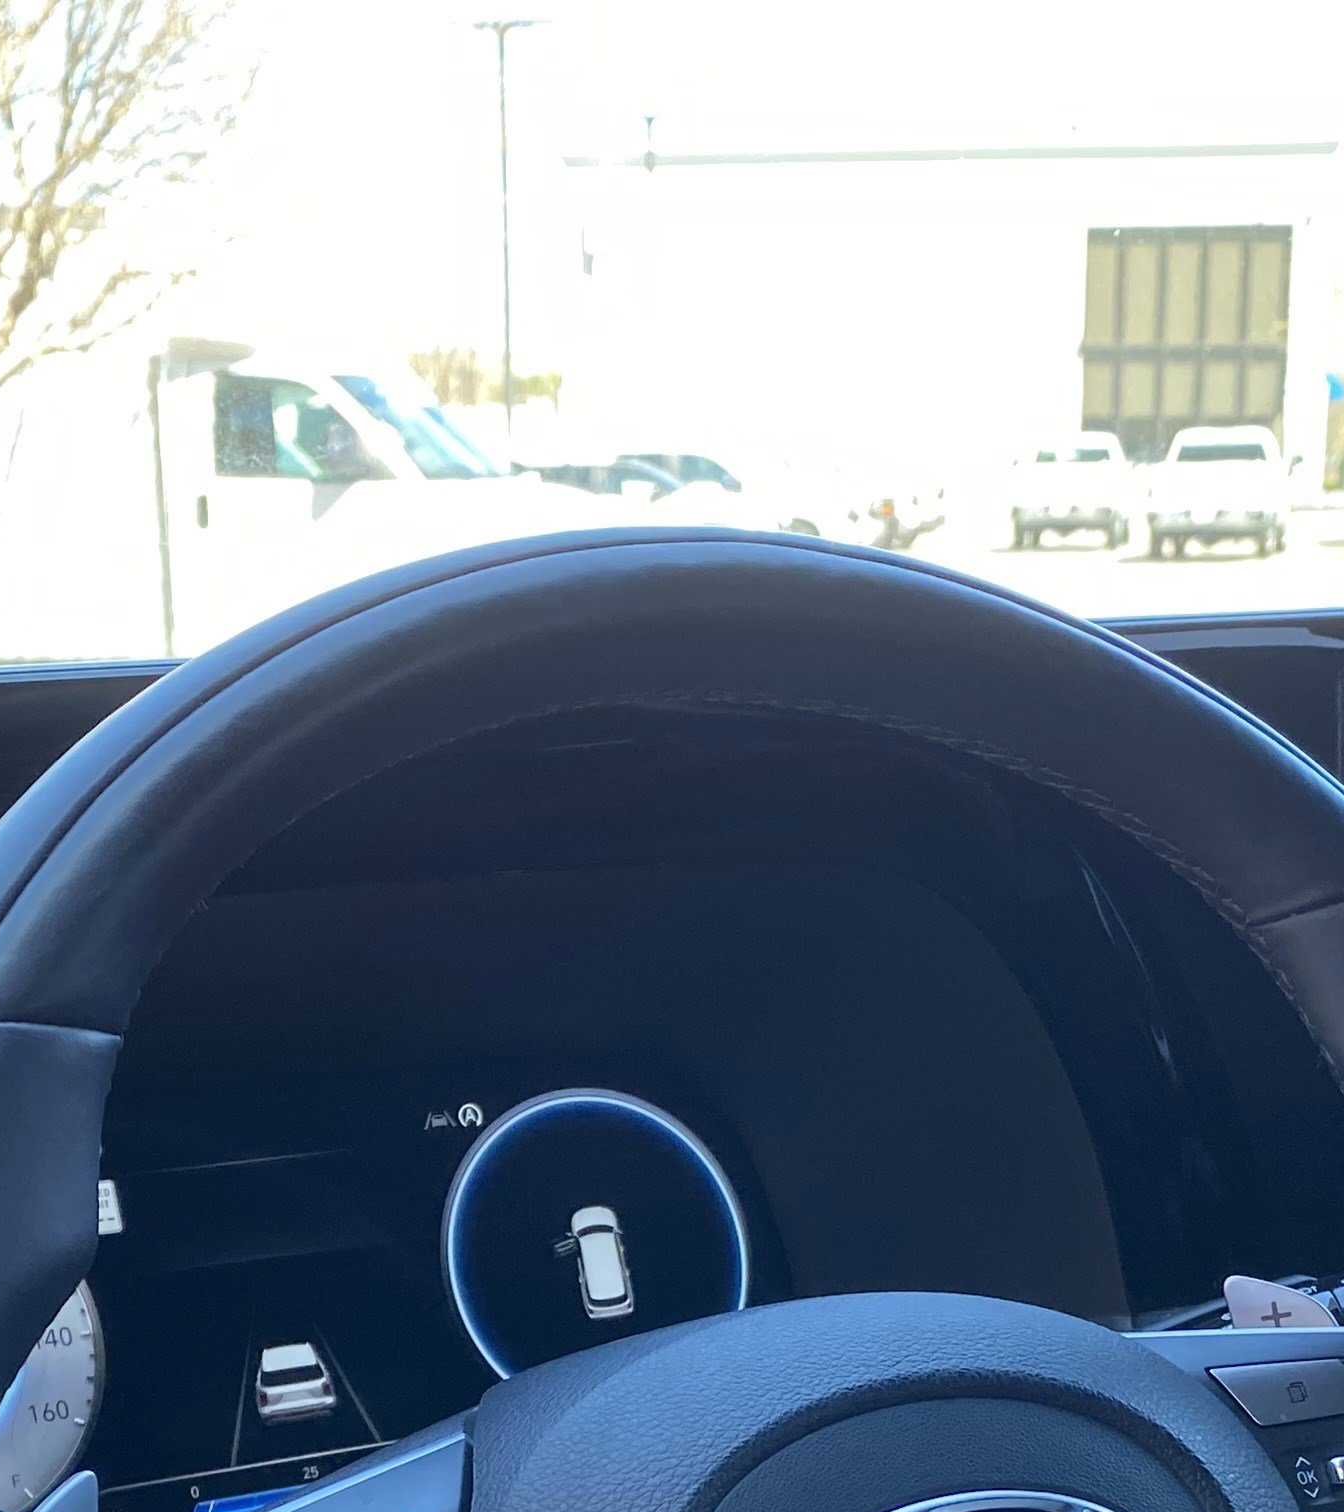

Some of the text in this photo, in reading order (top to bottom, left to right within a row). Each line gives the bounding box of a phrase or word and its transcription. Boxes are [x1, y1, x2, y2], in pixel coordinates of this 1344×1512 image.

[29, 1400, 70, 1424] 160
[11, 1473, 21, 1489] F
[190, 1466, 319, 1499] 0 25
[1296, 1468, 1319, 1485] OK
